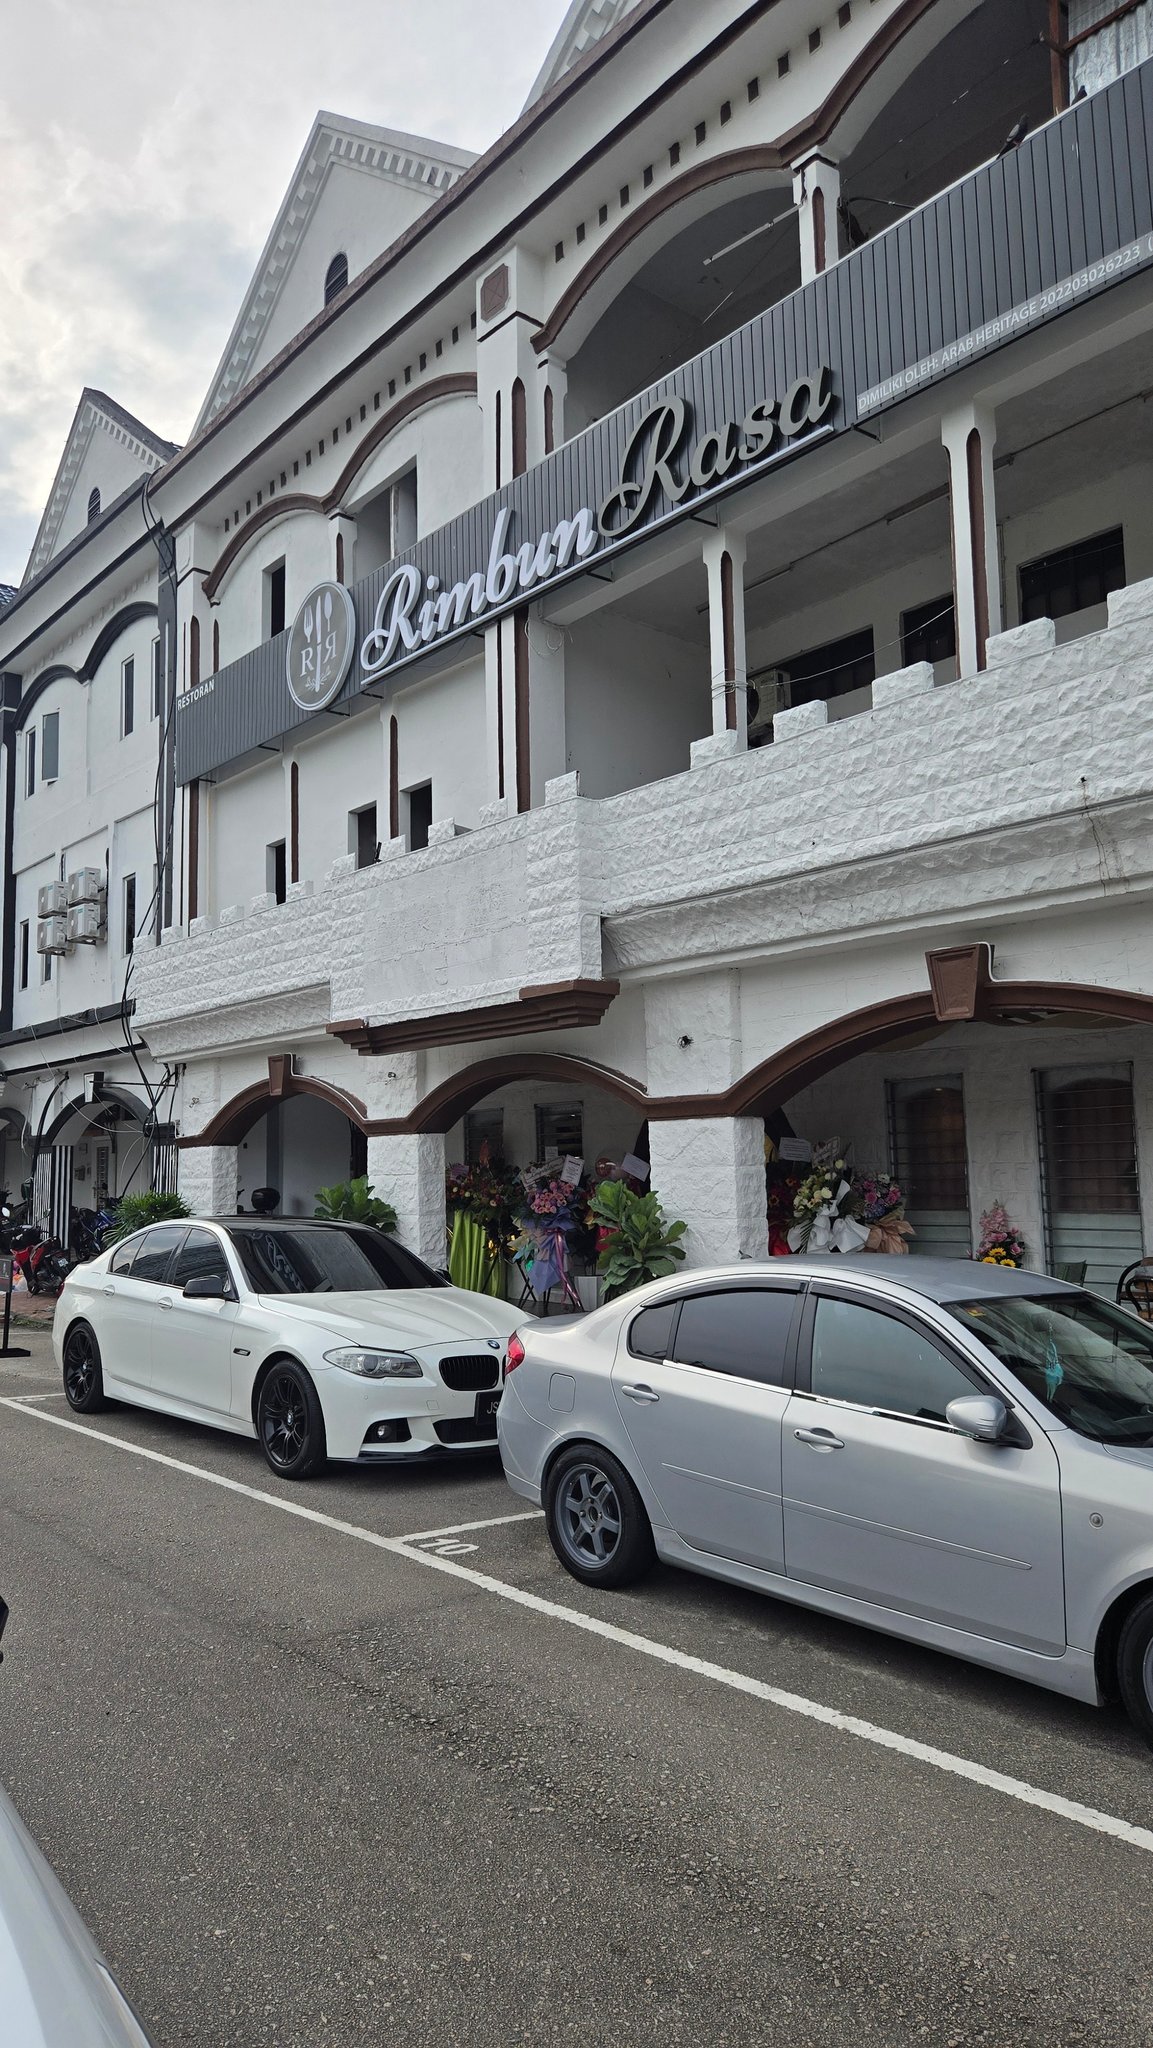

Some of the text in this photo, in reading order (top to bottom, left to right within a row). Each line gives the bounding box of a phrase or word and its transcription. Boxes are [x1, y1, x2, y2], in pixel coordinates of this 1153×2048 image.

[858, 376, 904, 411] DIMILIKI
[904, 357, 940, 384] OLEH:
[941, 336, 974, 365] ARAB
[975, 301, 1038, 346] HERITAGE
[1039, 244, 1141, 310] 202203026223
[360, 366, 833, 671] Rimbun Rasa
[177, 678, 215, 711] RESTORAN
[418, 1538, 480, 1556] 10
